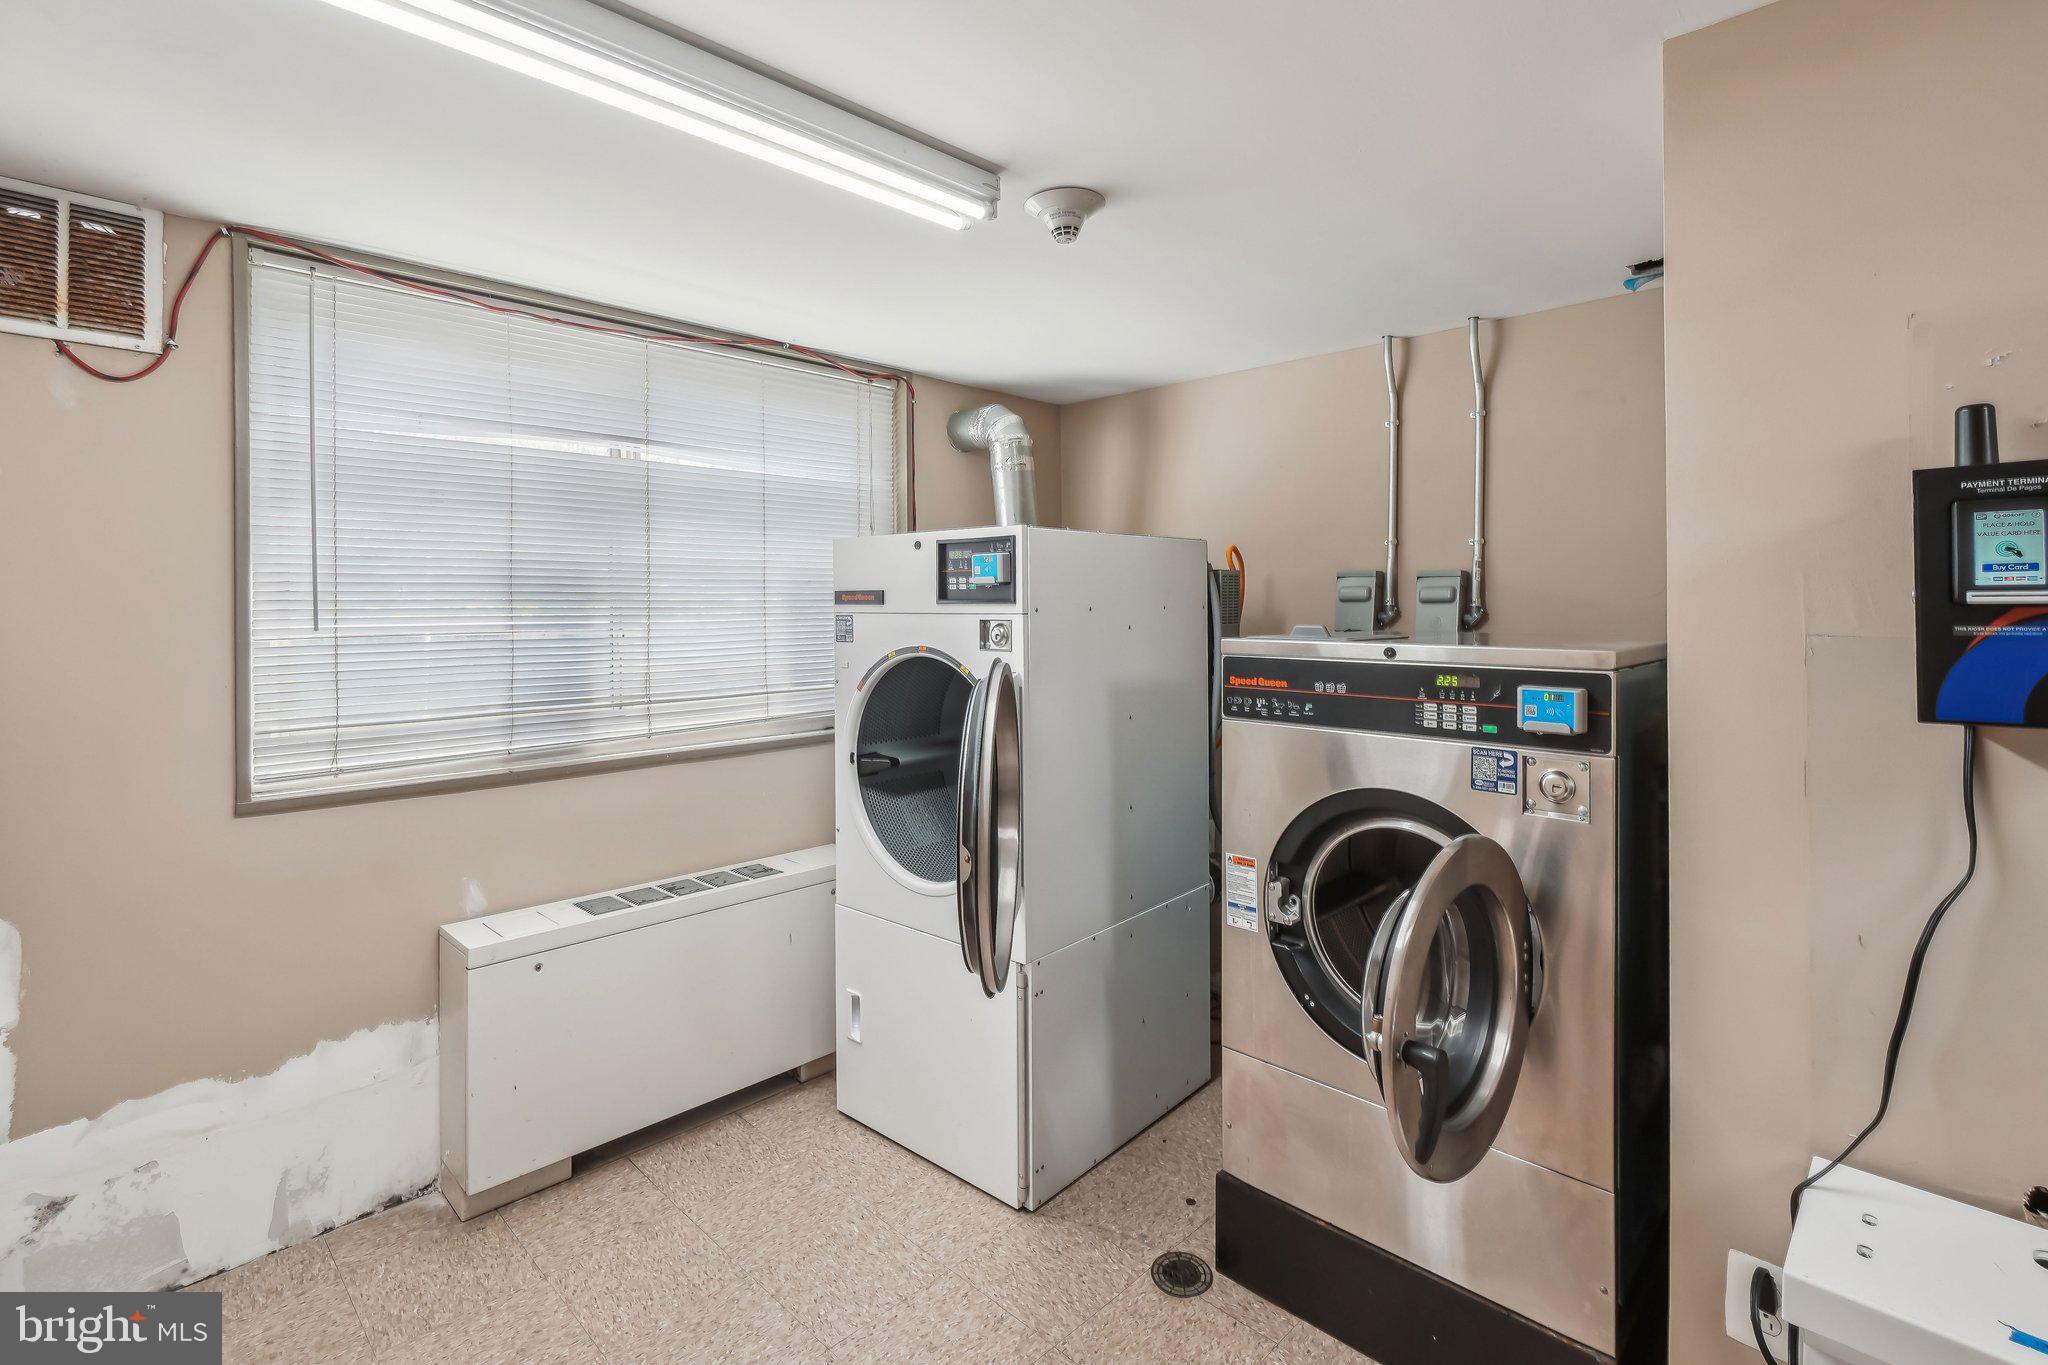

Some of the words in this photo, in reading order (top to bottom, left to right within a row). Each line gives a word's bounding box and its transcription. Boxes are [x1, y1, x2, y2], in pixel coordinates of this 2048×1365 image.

[1960, 479, 2005, 489] PAYMENT
[1977, 486, 2005, 494] Terminal
[1229, 675, 1257, 686] Speed
[1258, 677, 1288, 688] Queen
[1473, 748, 1488, 756] SCAN
[1488, 750, 1503, 758] HERE
